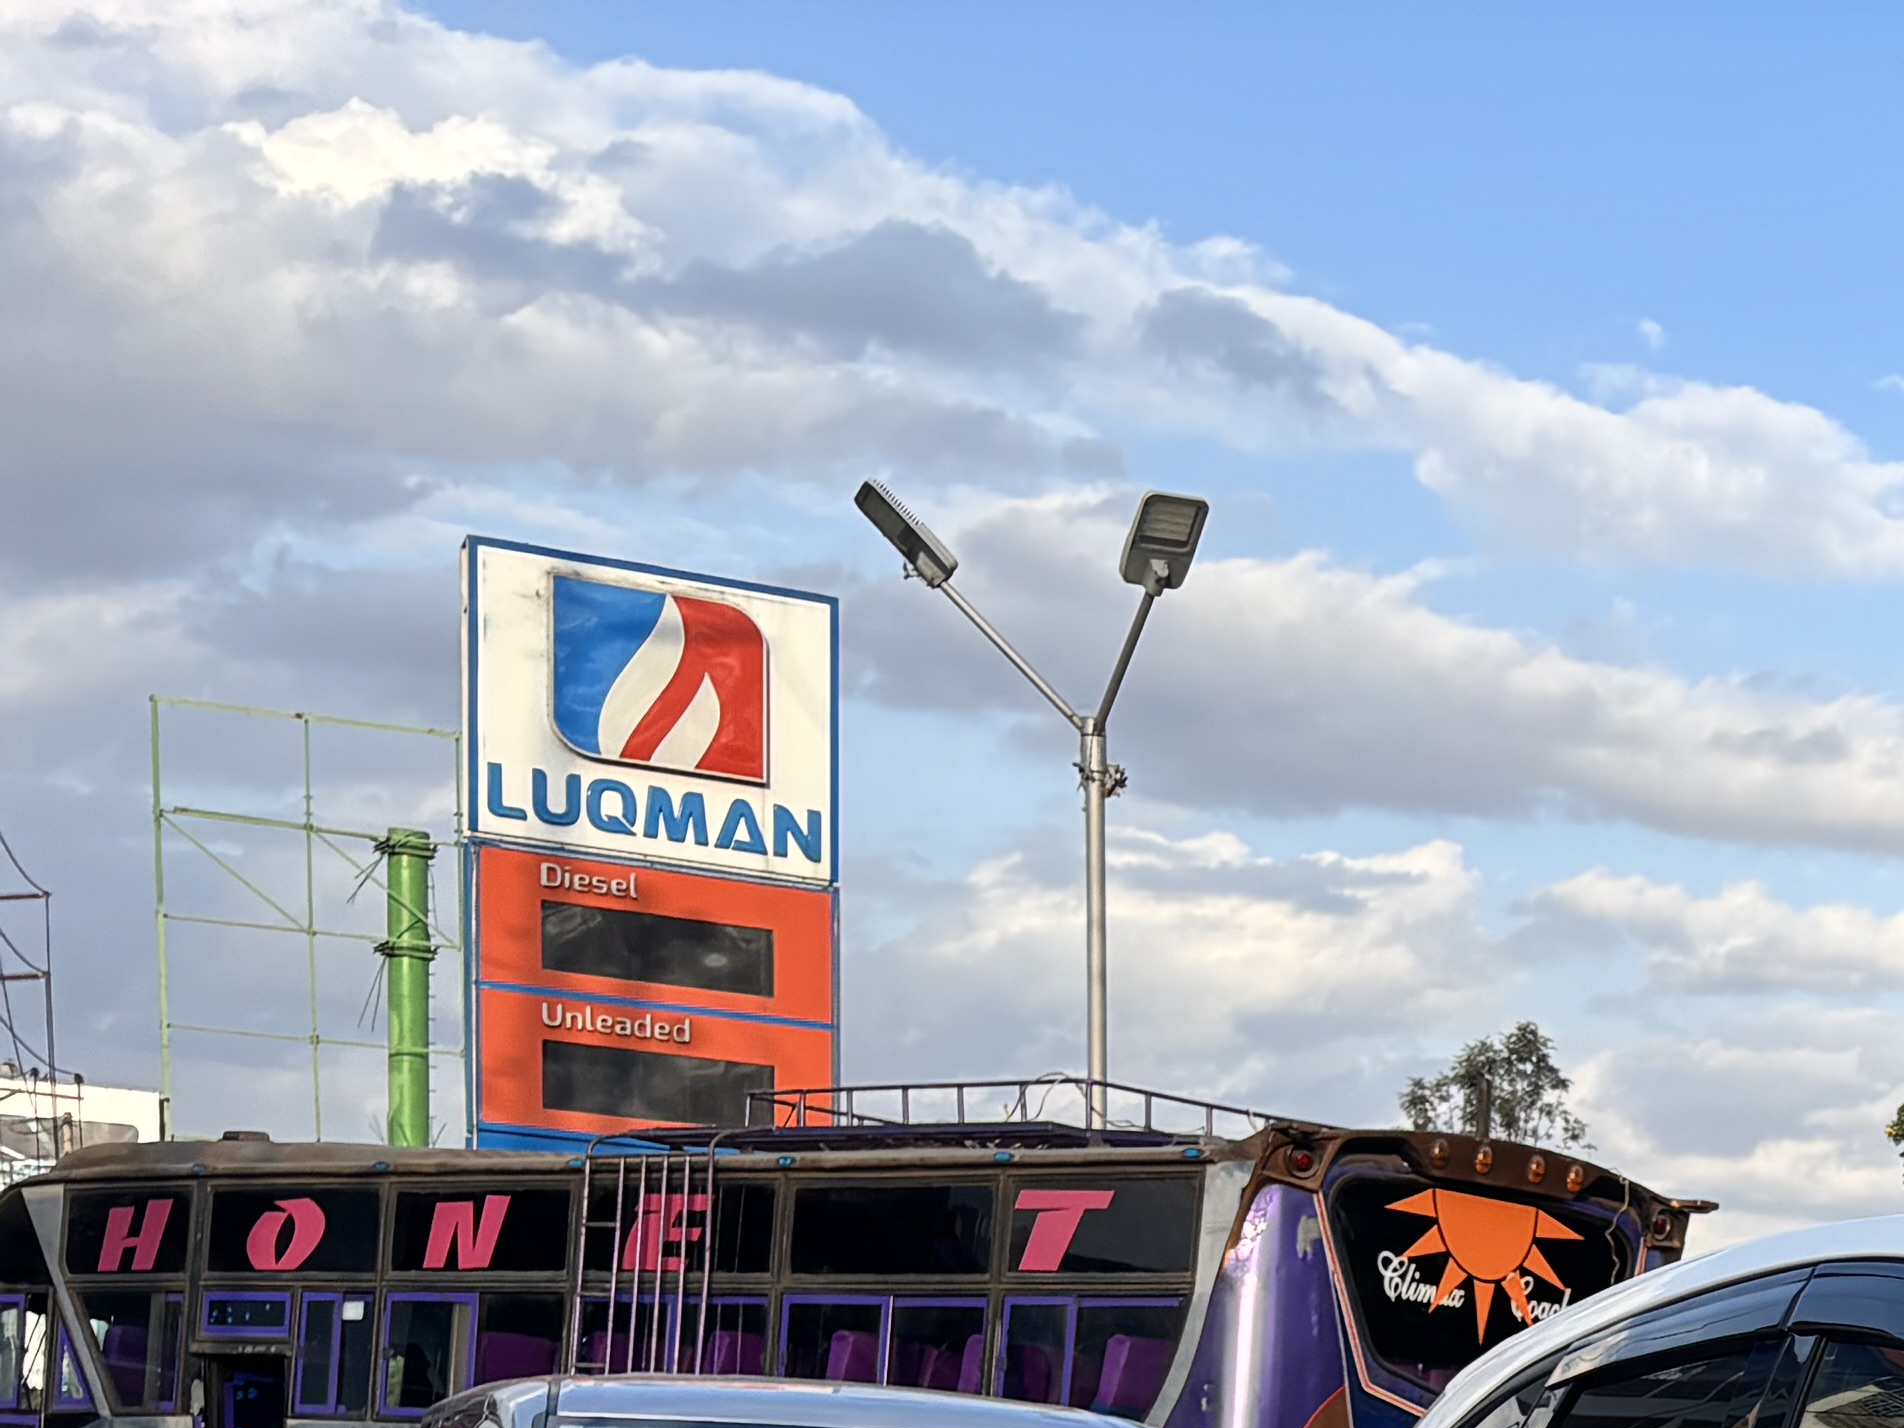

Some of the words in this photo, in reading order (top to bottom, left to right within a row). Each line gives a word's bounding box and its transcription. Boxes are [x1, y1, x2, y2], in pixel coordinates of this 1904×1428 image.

[487, 762, 822, 863] LUQMAN
[540, 862, 639, 900] Diesel
[541, 1002, 692, 1044] Unleaded
